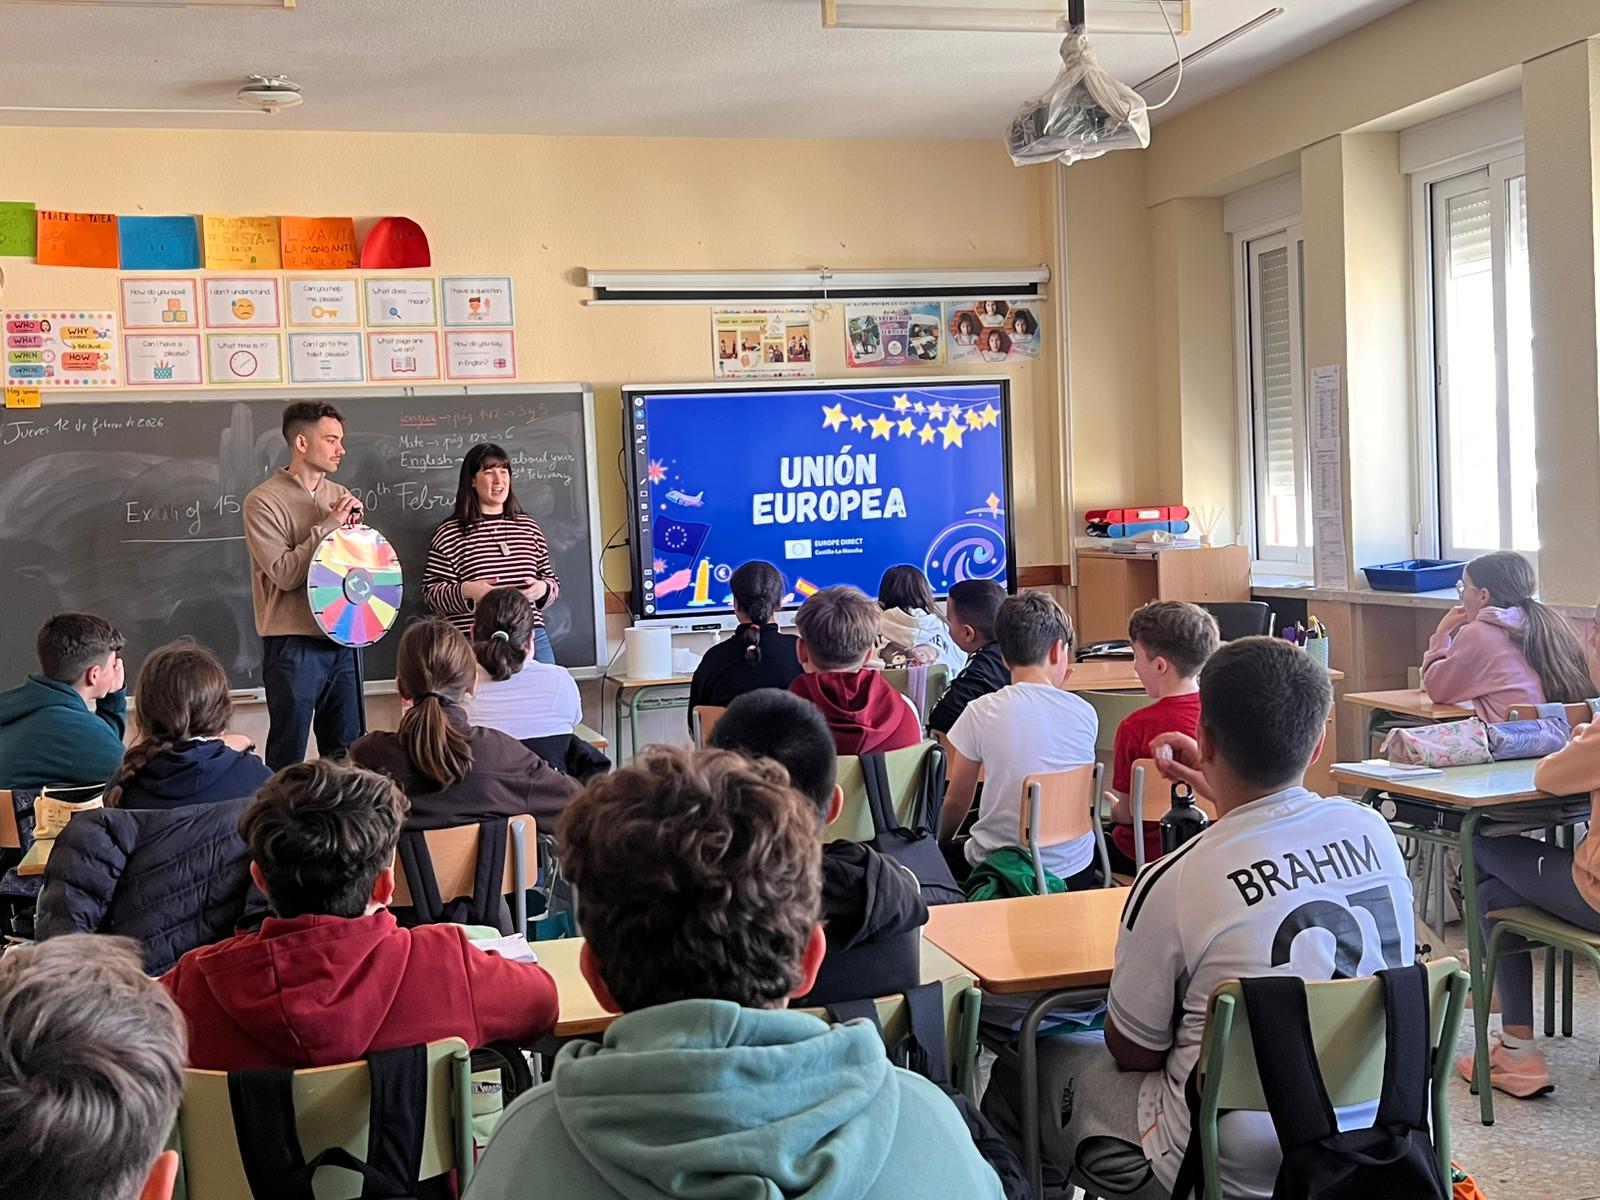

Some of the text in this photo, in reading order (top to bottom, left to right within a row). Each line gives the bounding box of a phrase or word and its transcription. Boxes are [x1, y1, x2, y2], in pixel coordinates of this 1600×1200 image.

[170, 289, 186, 297] spell
[3, 420, 51, 445] Jueves
[54, 417, 69, 431] 12
[74, 418, 87, 432] de
[136, 417, 164, 428] 2026
[400, 435, 424, 448] Mate
[401, 451, 453, 473] English
[511, 451, 548, 464] about
[780, 444, 877, 488] UNIÓN
[752, 487, 907, 525] EUROPEA
[814, 539, 840, 547] EUROPE
[1226, 834, 1382, 907] BRAHIM
